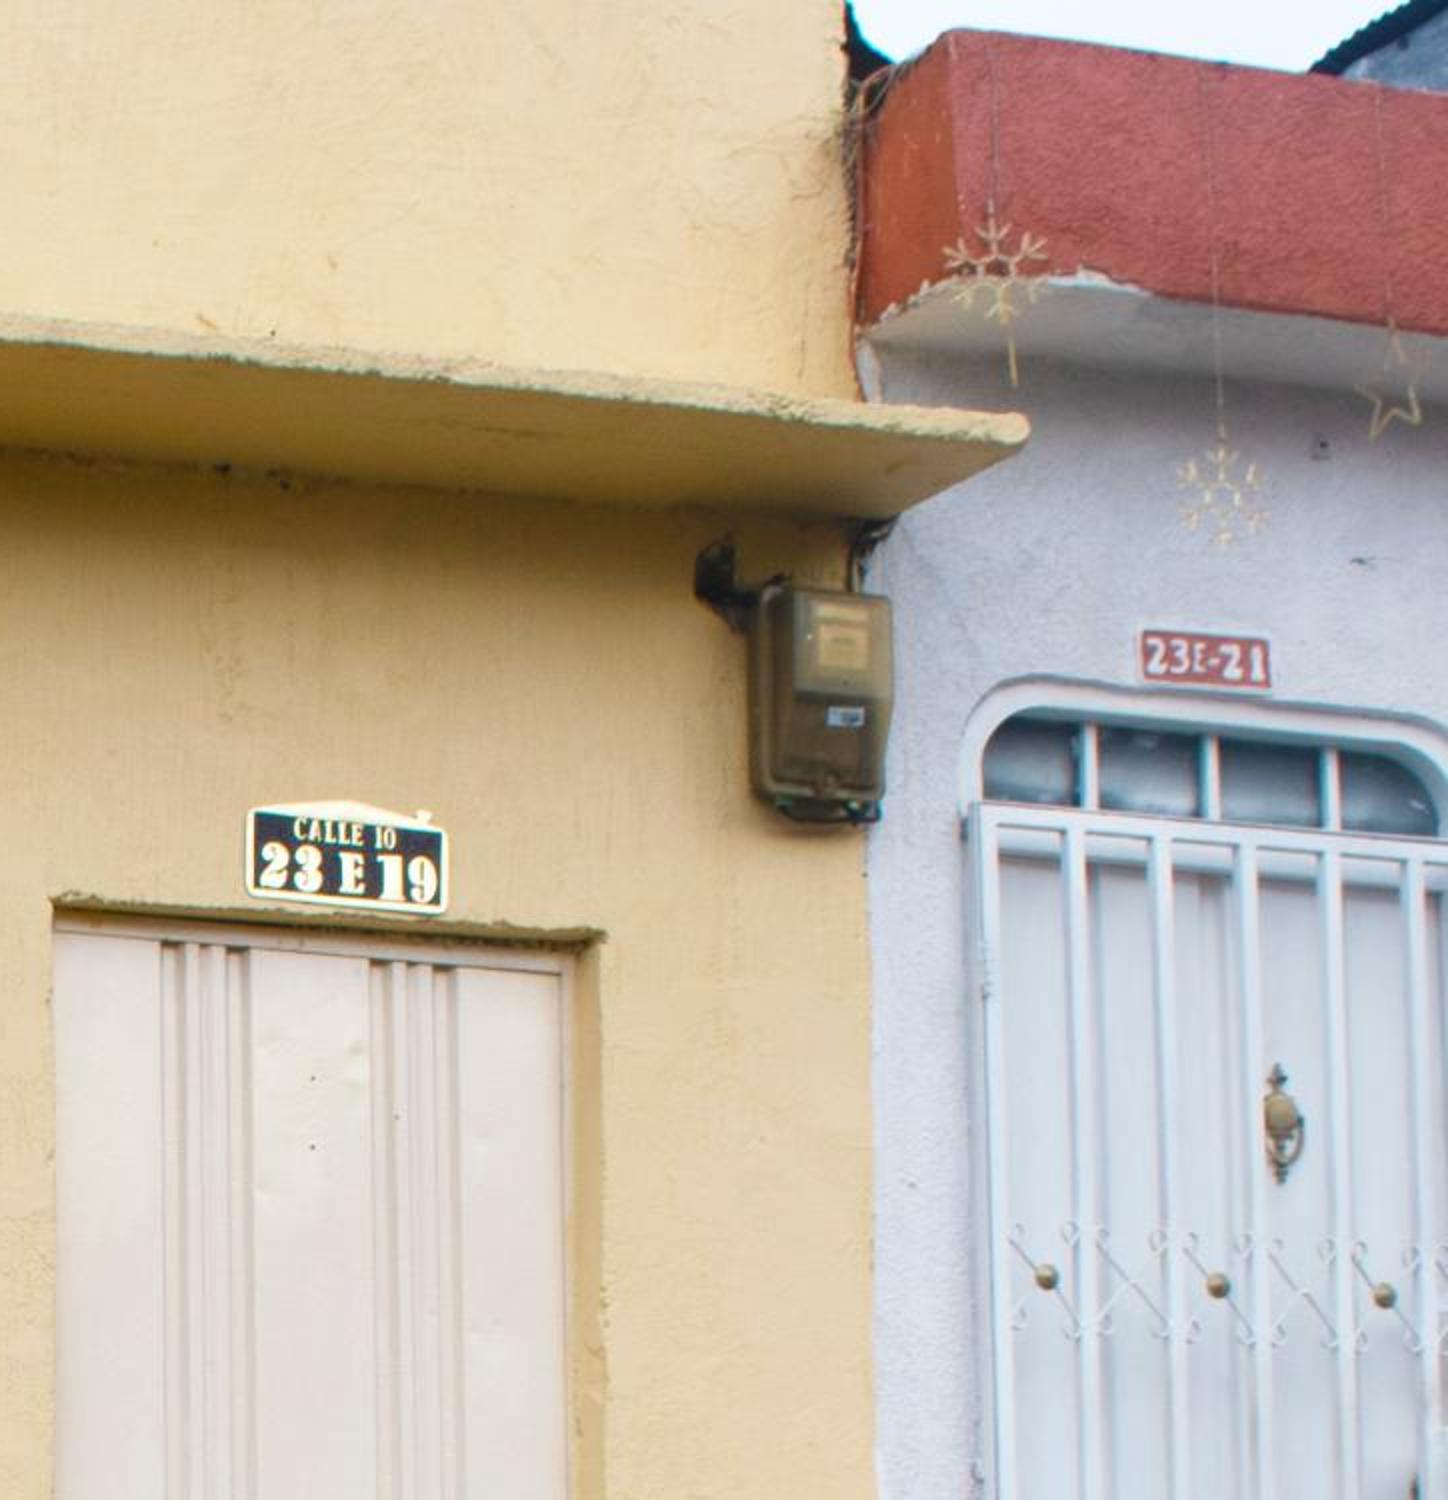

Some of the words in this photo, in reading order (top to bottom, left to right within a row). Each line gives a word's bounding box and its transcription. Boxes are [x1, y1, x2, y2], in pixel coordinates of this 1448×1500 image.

[1146, 636, 1266, 682] 23E-21
[294, 816, 364, 846] CALLE
[375, 827, 396, 849] 10
[260, 842, 323, 893] 23
[338, 851, 365, 894] E
[377, 854, 437, 904] 19
